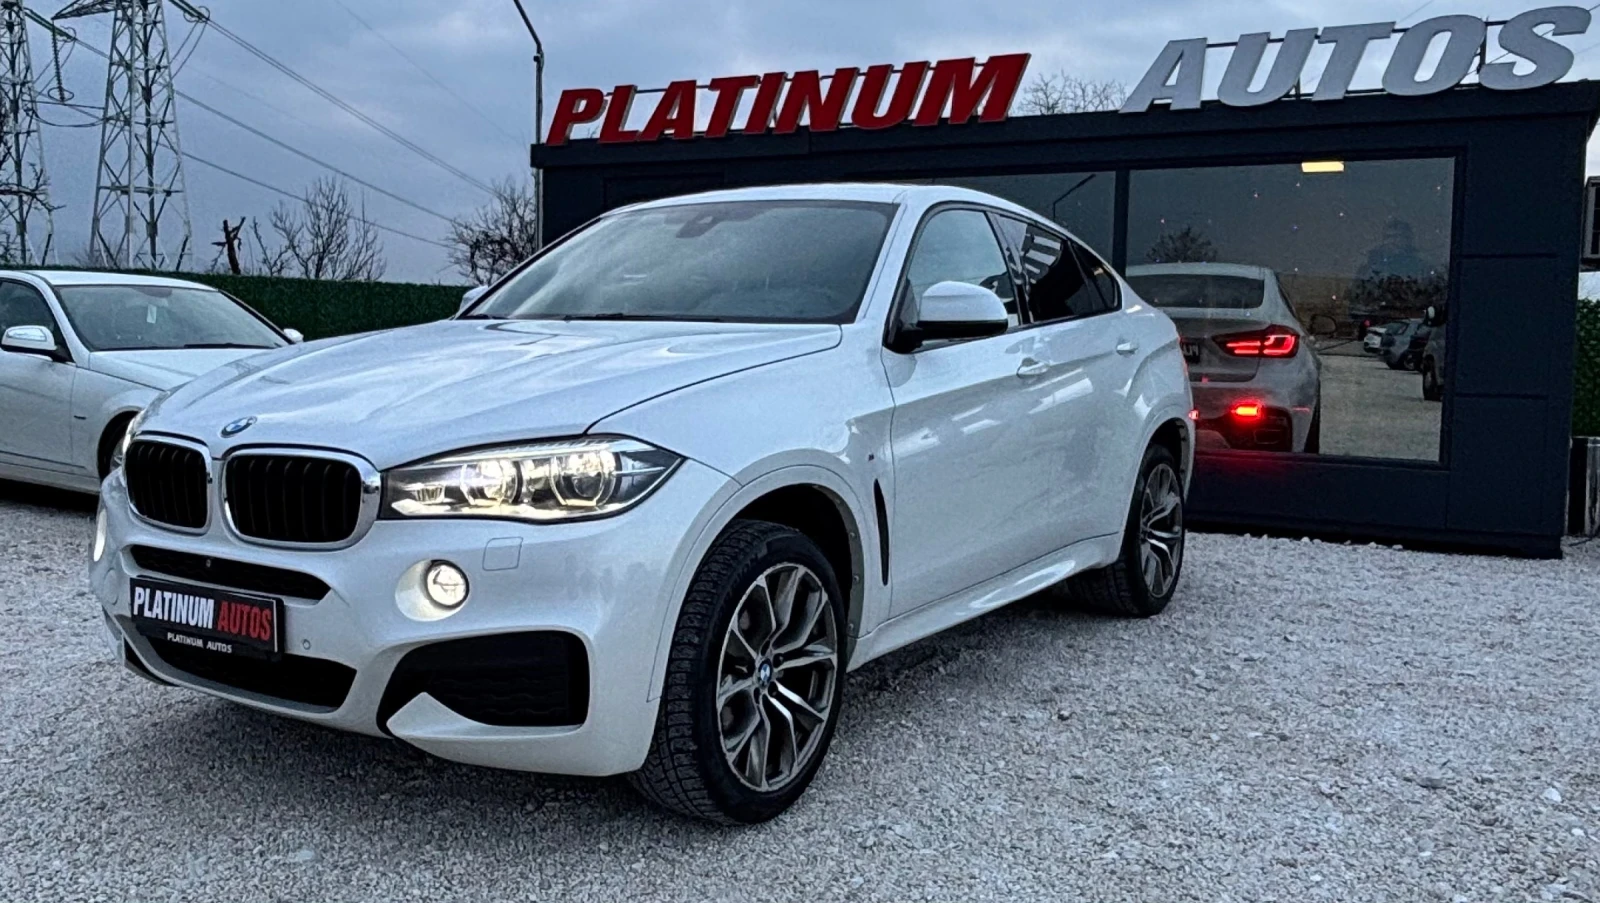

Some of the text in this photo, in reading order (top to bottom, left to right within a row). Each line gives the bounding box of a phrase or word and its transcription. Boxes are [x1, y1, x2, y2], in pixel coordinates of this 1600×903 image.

[546, 5, 1592, 146] PLATINUM AUTOS
[133, 586, 272, 641] PLATINUM AUTOS
[167, 632, 232, 654] PLATINUM AUTOS
